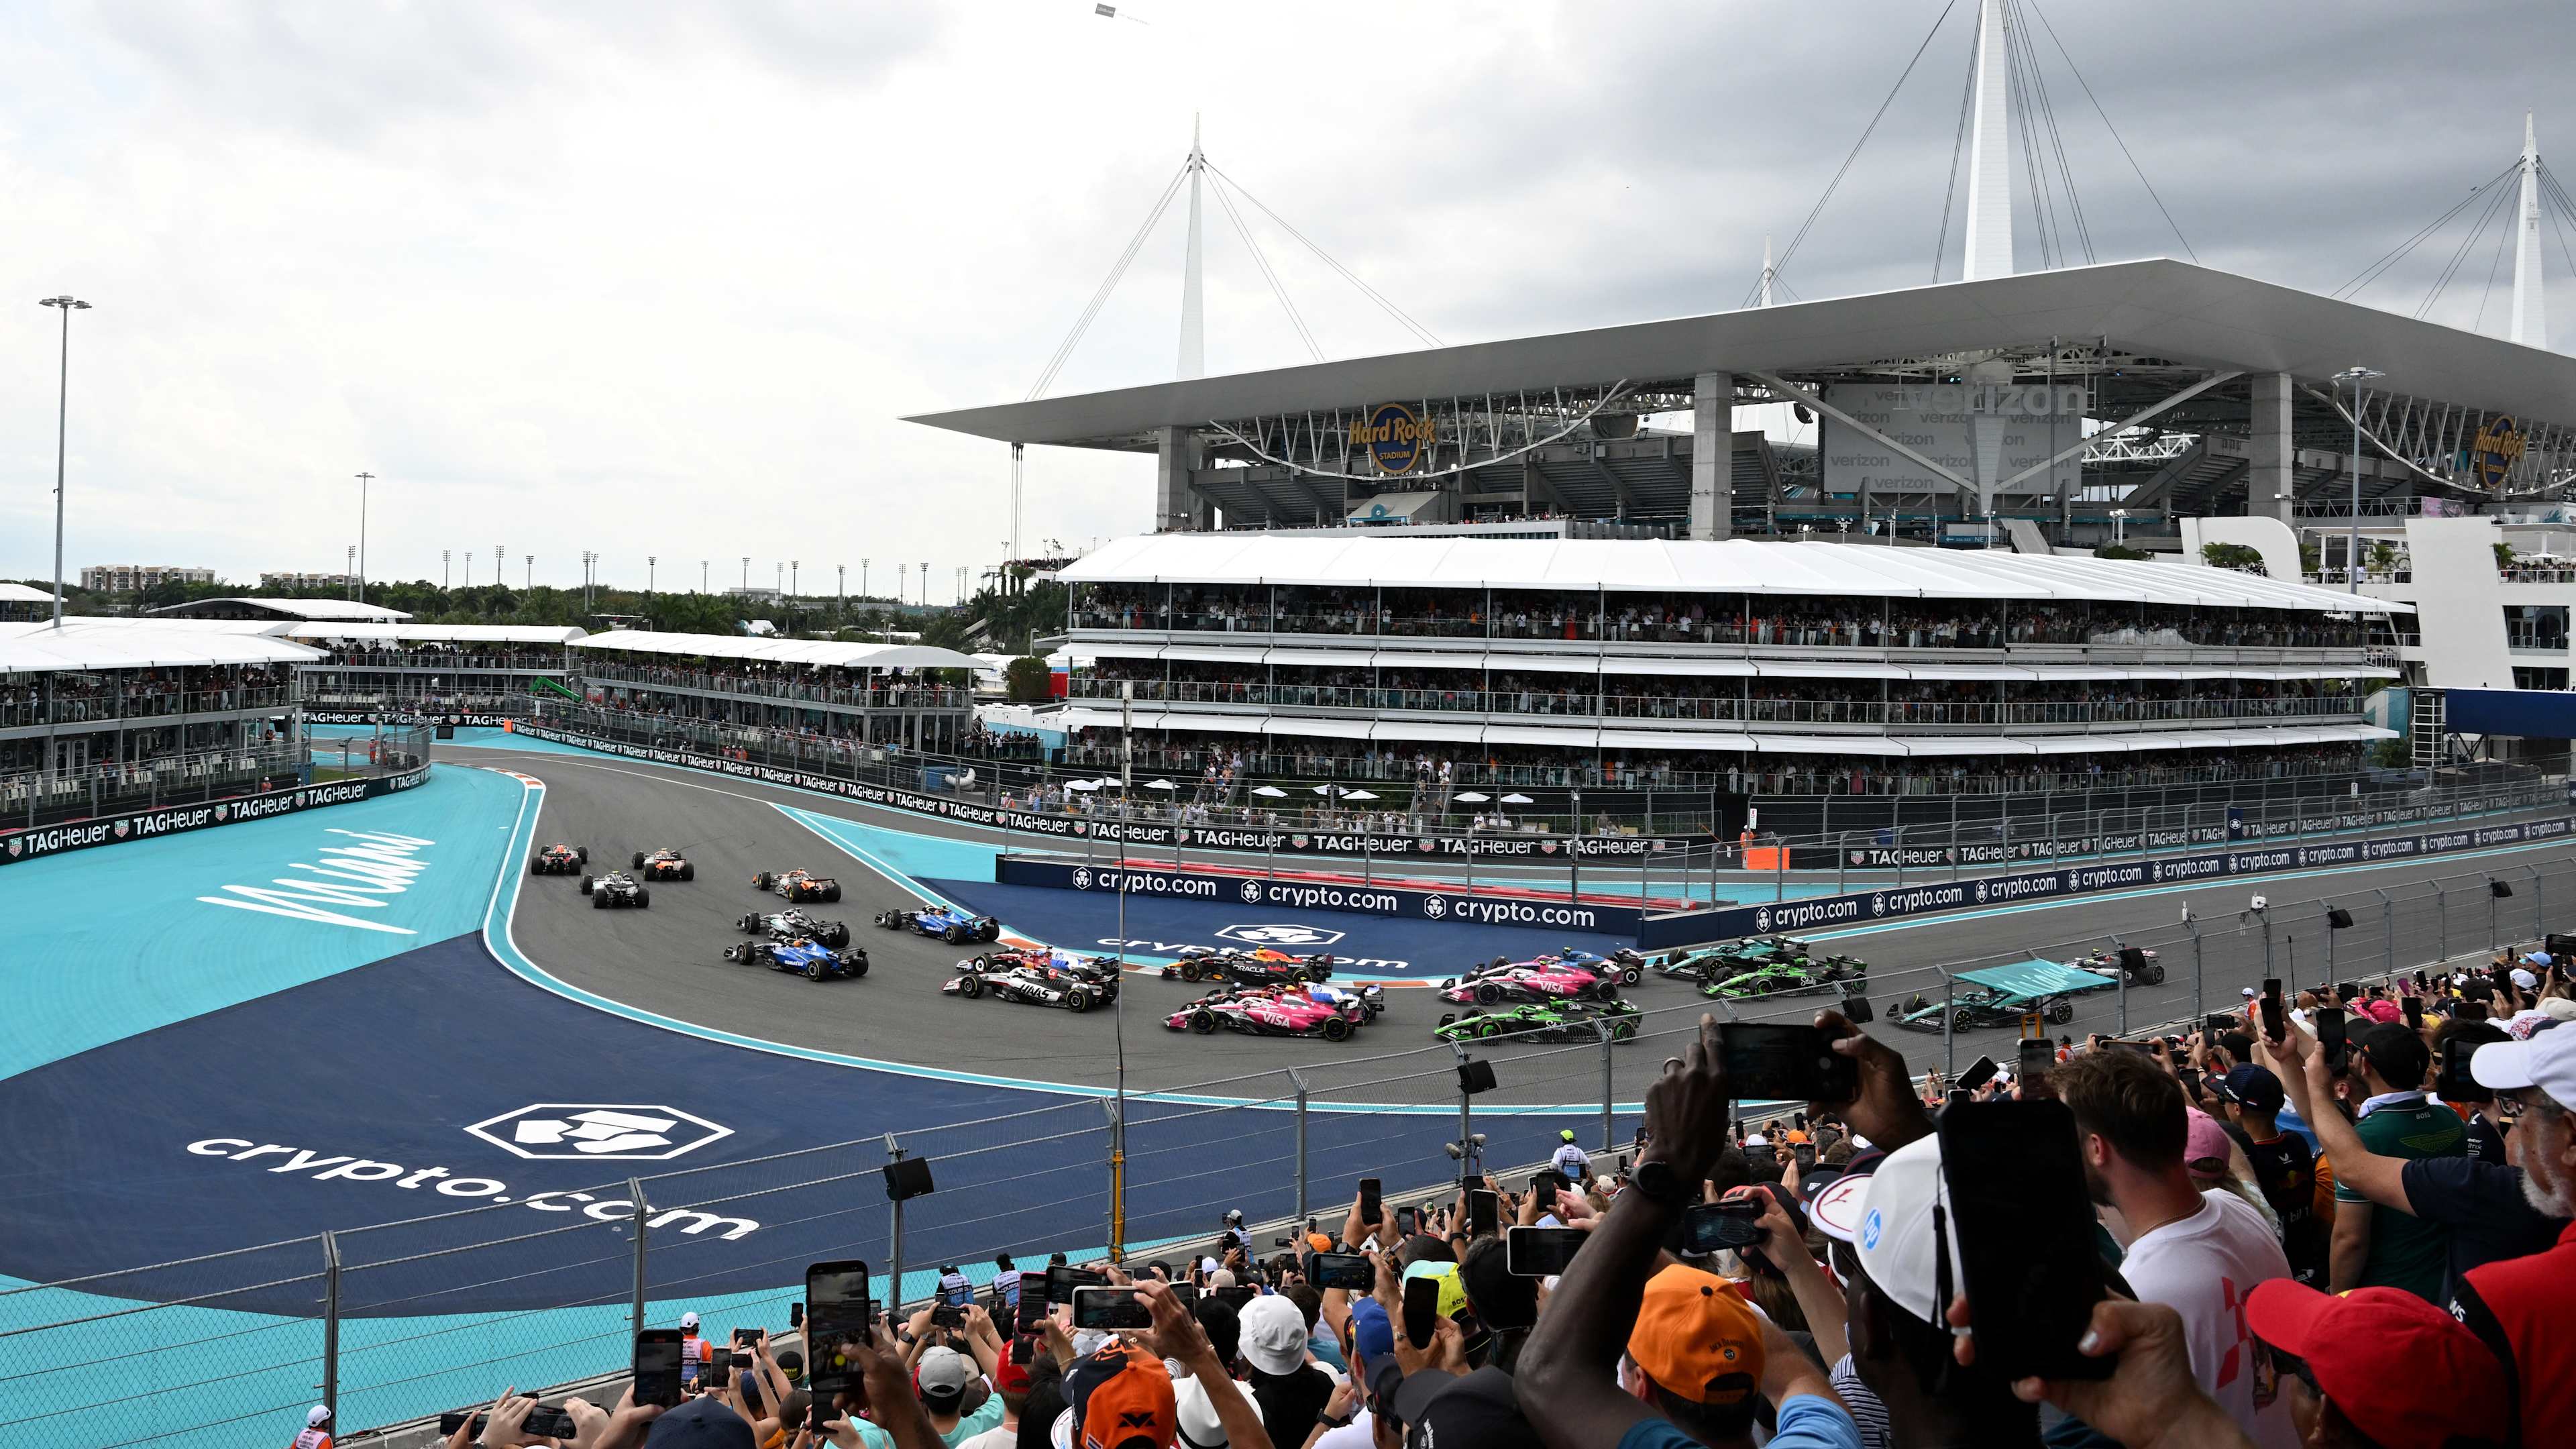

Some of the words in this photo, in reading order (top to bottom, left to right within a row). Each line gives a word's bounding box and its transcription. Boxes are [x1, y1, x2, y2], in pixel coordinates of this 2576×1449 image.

[1921, 412, 1969, 425] verizo
[1349, 419, 1390, 445] Hard
[1393, 413, 1437, 445] Rock
[1891, 431, 1934, 446] erizon
[1379, 451, 1410, 460] STADIUM
[1831, 453, 1890, 468] verizon
[1927, 453, 1973, 468] erizo
[2008, 454, 2072, 468] verin
[1874, 475, 1934, 490] verizon
[308, 784, 366, 806] TAGHeuer
[2496, 796, 2522, 807] TAGHuer
[231, 795, 293, 819] TAGHeuer
[2460, 800, 2488, 812] TAGHeur
[133, 808, 211, 836] TAGHeuer
[1009, 814, 1070, 833] TAGHeuer
[2342, 813, 2375, 827] TAGHeer
[2532, 820, 2565, 837] crypto.com
[26, 824, 110, 854] TAGHeuer
[1194, 830, 1286, 848] TAGHeuer
[1314, 835, 1412, 852] TAGHeuer
[2429, 833, 2468, 850] crypto.com
[2482, 828, 2518, 843] crypto.com
[2309, 845, 2354, 863] crypto.com
[2371, 840, 2413, 857] crypto.com
[2165, 858, 2219, 879] crypto.com
[2241, 851, 2290, 871] crypto.com
[1099, 871, 1217, 896] crypto.com
[2082, 866, 2142, 888] crypto.com
[1991, 875, 2057, 899] crypto.com
[1269, 885, 1397, 910] crypto.com
[1890, 886, 1962, 912] crypto.com
[1455, 900, 1595, 928] crypto.com
[1776, 900, 1857, 928] crypto.com
[1097, 938, 1409, 969] cryptom
[1234, 965, 1266, 973] ORACLE
[1020, 983, 1054, 1000] HAAS
[1541, 982, 1564, 994] VISA
[1263, 1013, 1291, 1028] VISA
[2416, 1112, 2431, 1120] BOSS
[186, 1138, 759, 1241] crypto.com
[1864, 1210, 1879, 1246] hp
[1001, 1282, 1020, 1292] COURS
[1452, 1295, 1466, 1307] BOS
